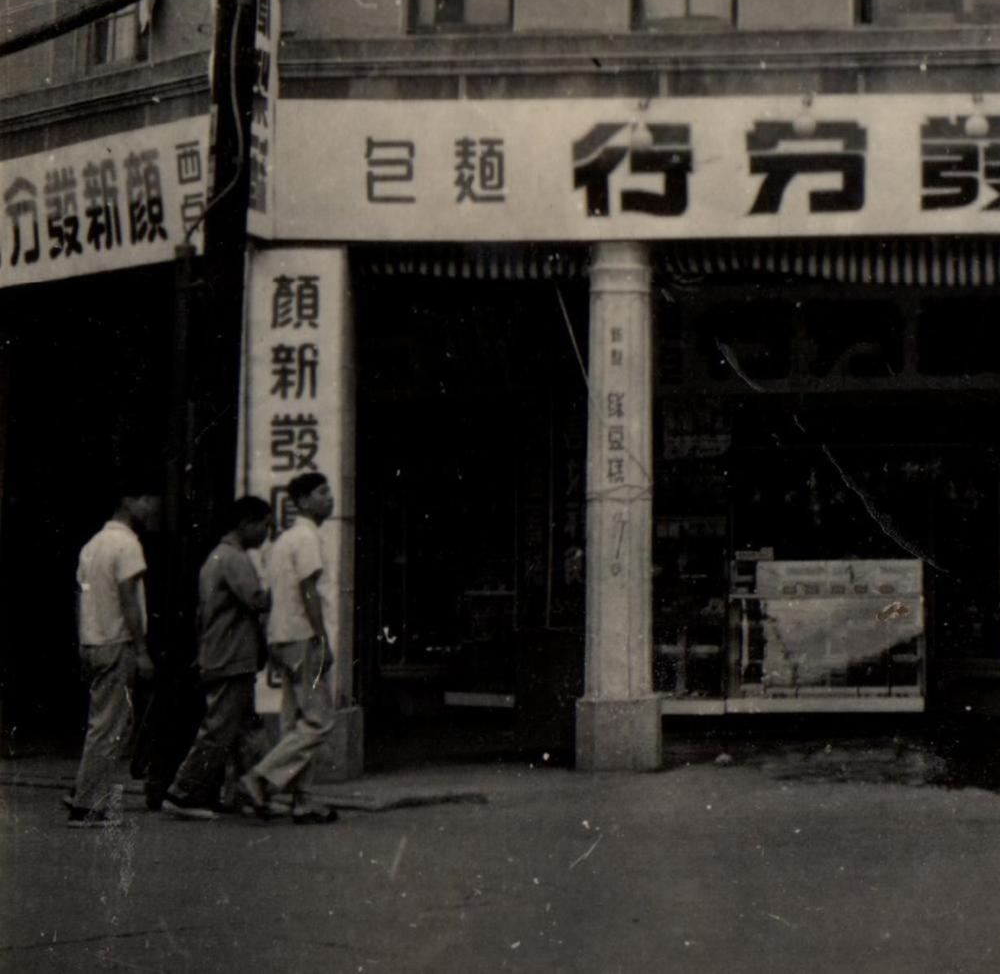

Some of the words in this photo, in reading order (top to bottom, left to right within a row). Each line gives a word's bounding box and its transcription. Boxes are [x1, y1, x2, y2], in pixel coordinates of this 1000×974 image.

[0, 148, 168, 267] 顏新發分
[364, 136, 507, 204] 麵包
